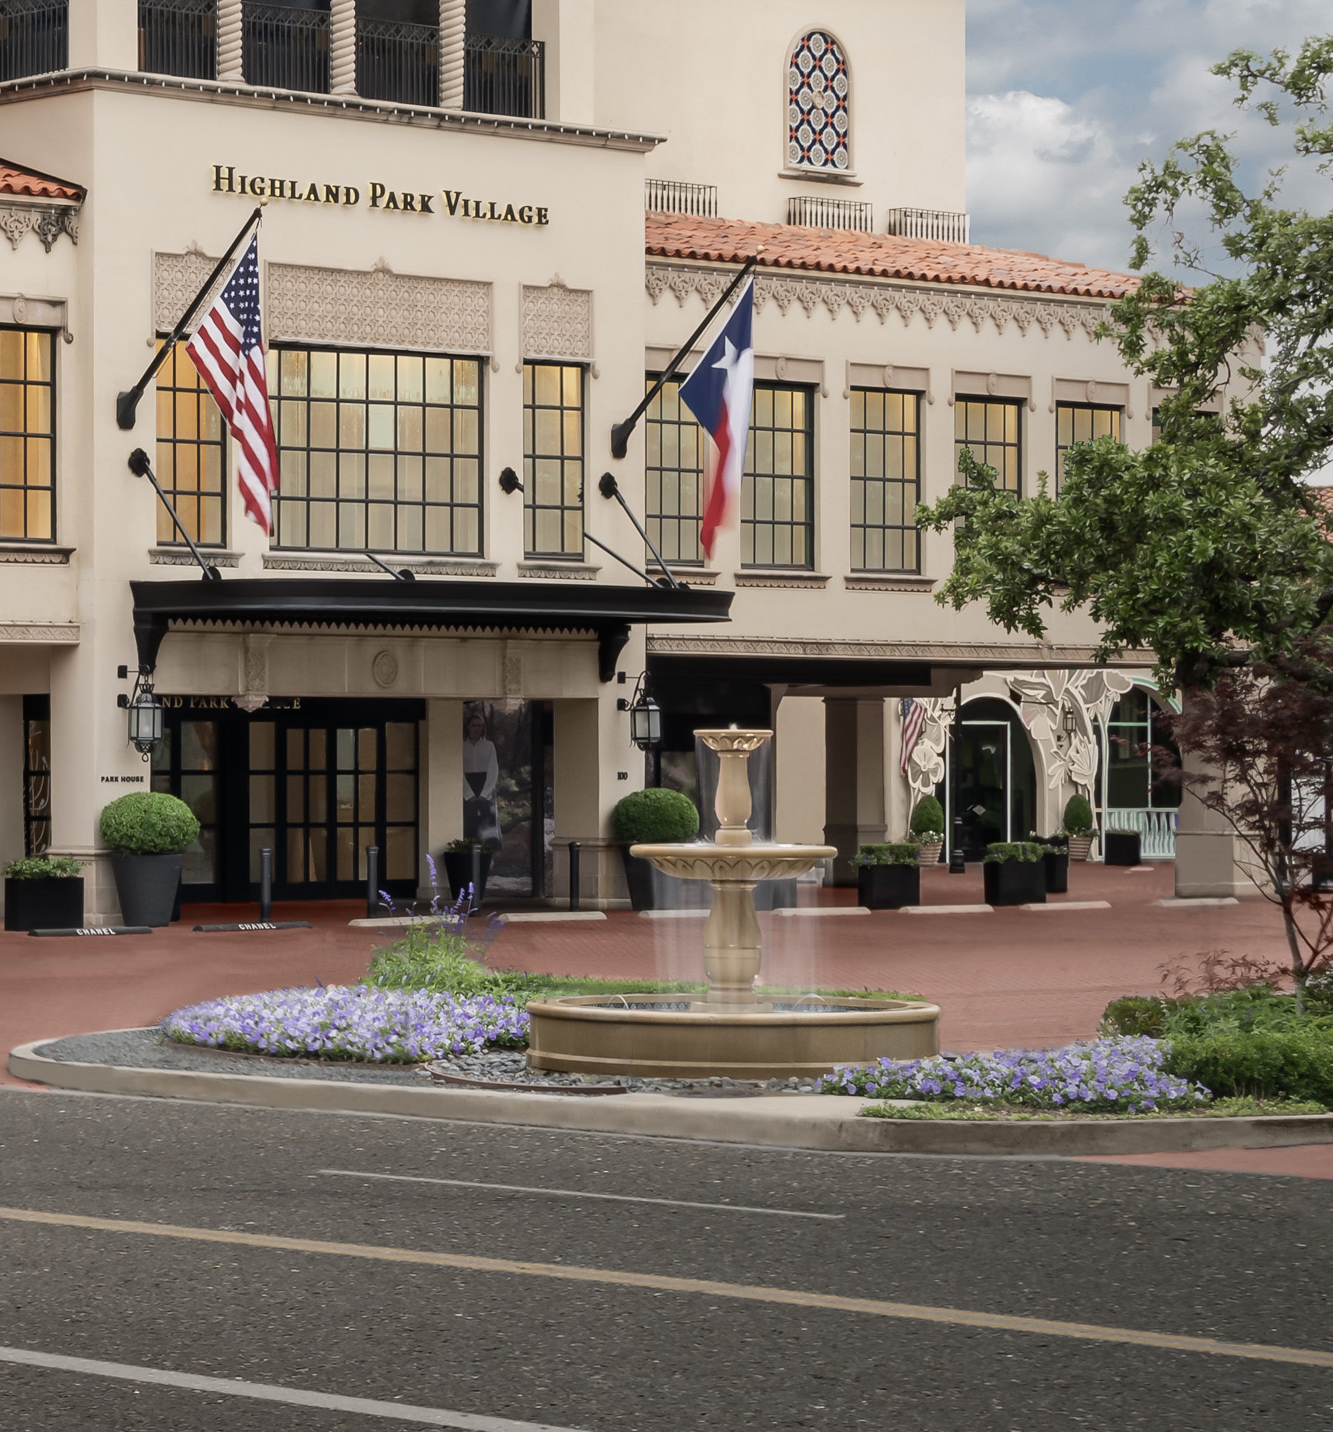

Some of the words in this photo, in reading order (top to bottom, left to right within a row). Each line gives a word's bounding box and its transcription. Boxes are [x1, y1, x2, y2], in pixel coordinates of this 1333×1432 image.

[212, 165, 360, 205] HIGHLAND
[369, 181, 435, 213] PARK
[443, 189, 549, 225] VILLAGE
[190, 695, 229, 709] PARK
[100, 775, 119, 783] PARK
[120, 775, 144, 783] HOUSE
[238, 922, 277, 930] CHANEL
[76, 928, 116, 936] CHANEL
